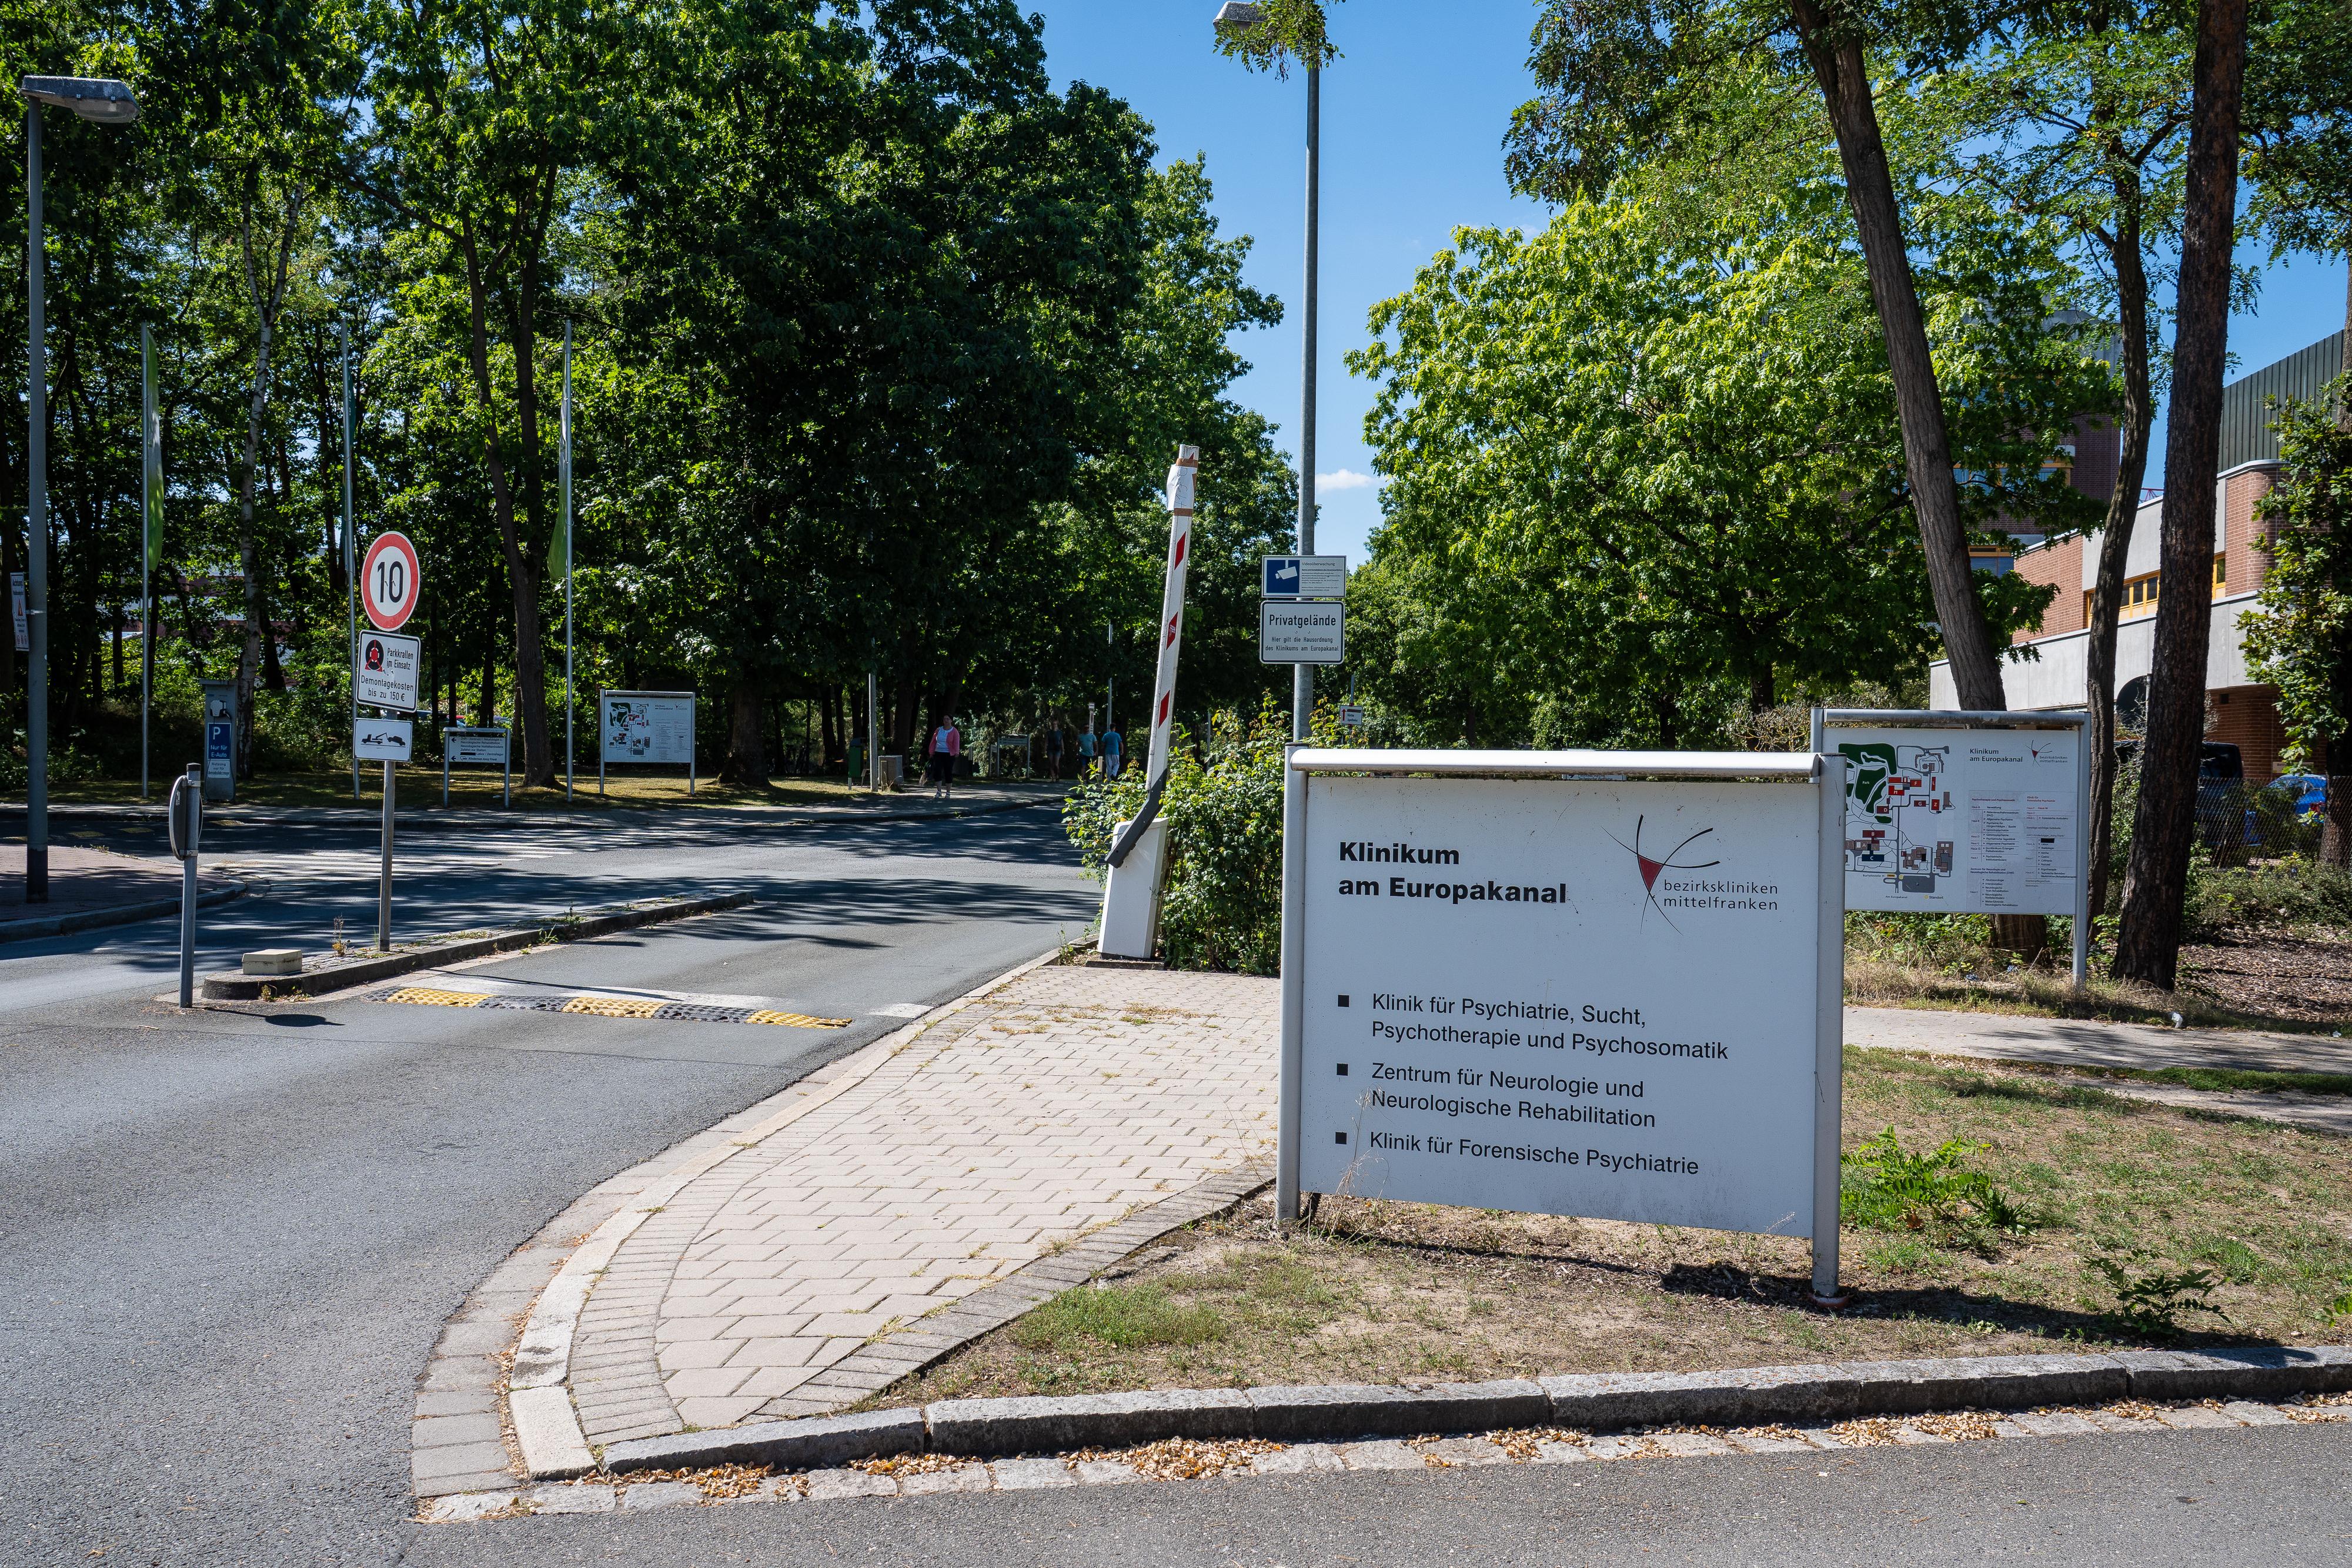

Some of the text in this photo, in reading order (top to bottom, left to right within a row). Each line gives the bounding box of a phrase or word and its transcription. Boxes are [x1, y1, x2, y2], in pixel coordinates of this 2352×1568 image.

[377, 561, 403, 603] 10
[1269, 614, 1337, 628] Privatgelände
[386, 647, 414, 660] Parkkrallen
[386, 659, 411, 670] im Einsatz
[360, 674, 414, 693] Demontagekosten
[368, 687, 376, 697] bis
[390, 691, 399, 700] 150
[401, 693, 405, 701] €
[213, 727, 220, 740] P
[1339, 841, 1459, 865] Klinikum
[1338, 877, 1566, 905] am Europakanal
[1664, 879, 1778, 895] bezirkskliniken
[1663, 896, 1778, 911] mittelfranken
[1373, 993, 1645, 1028] Klinik für Psychiatrie, Sucht,
[1372, 1021, 1729, 1059] Psychotherapie und Psychosomatik
[1372, 1062, 1643, 1098] Zentrum für Neurologie und
[1372, 1090, 1655, 1128] Neurologische Rehabilitation
[1371, 1131, 1699, 1175] Klinik für Forensische Psychiatrie
